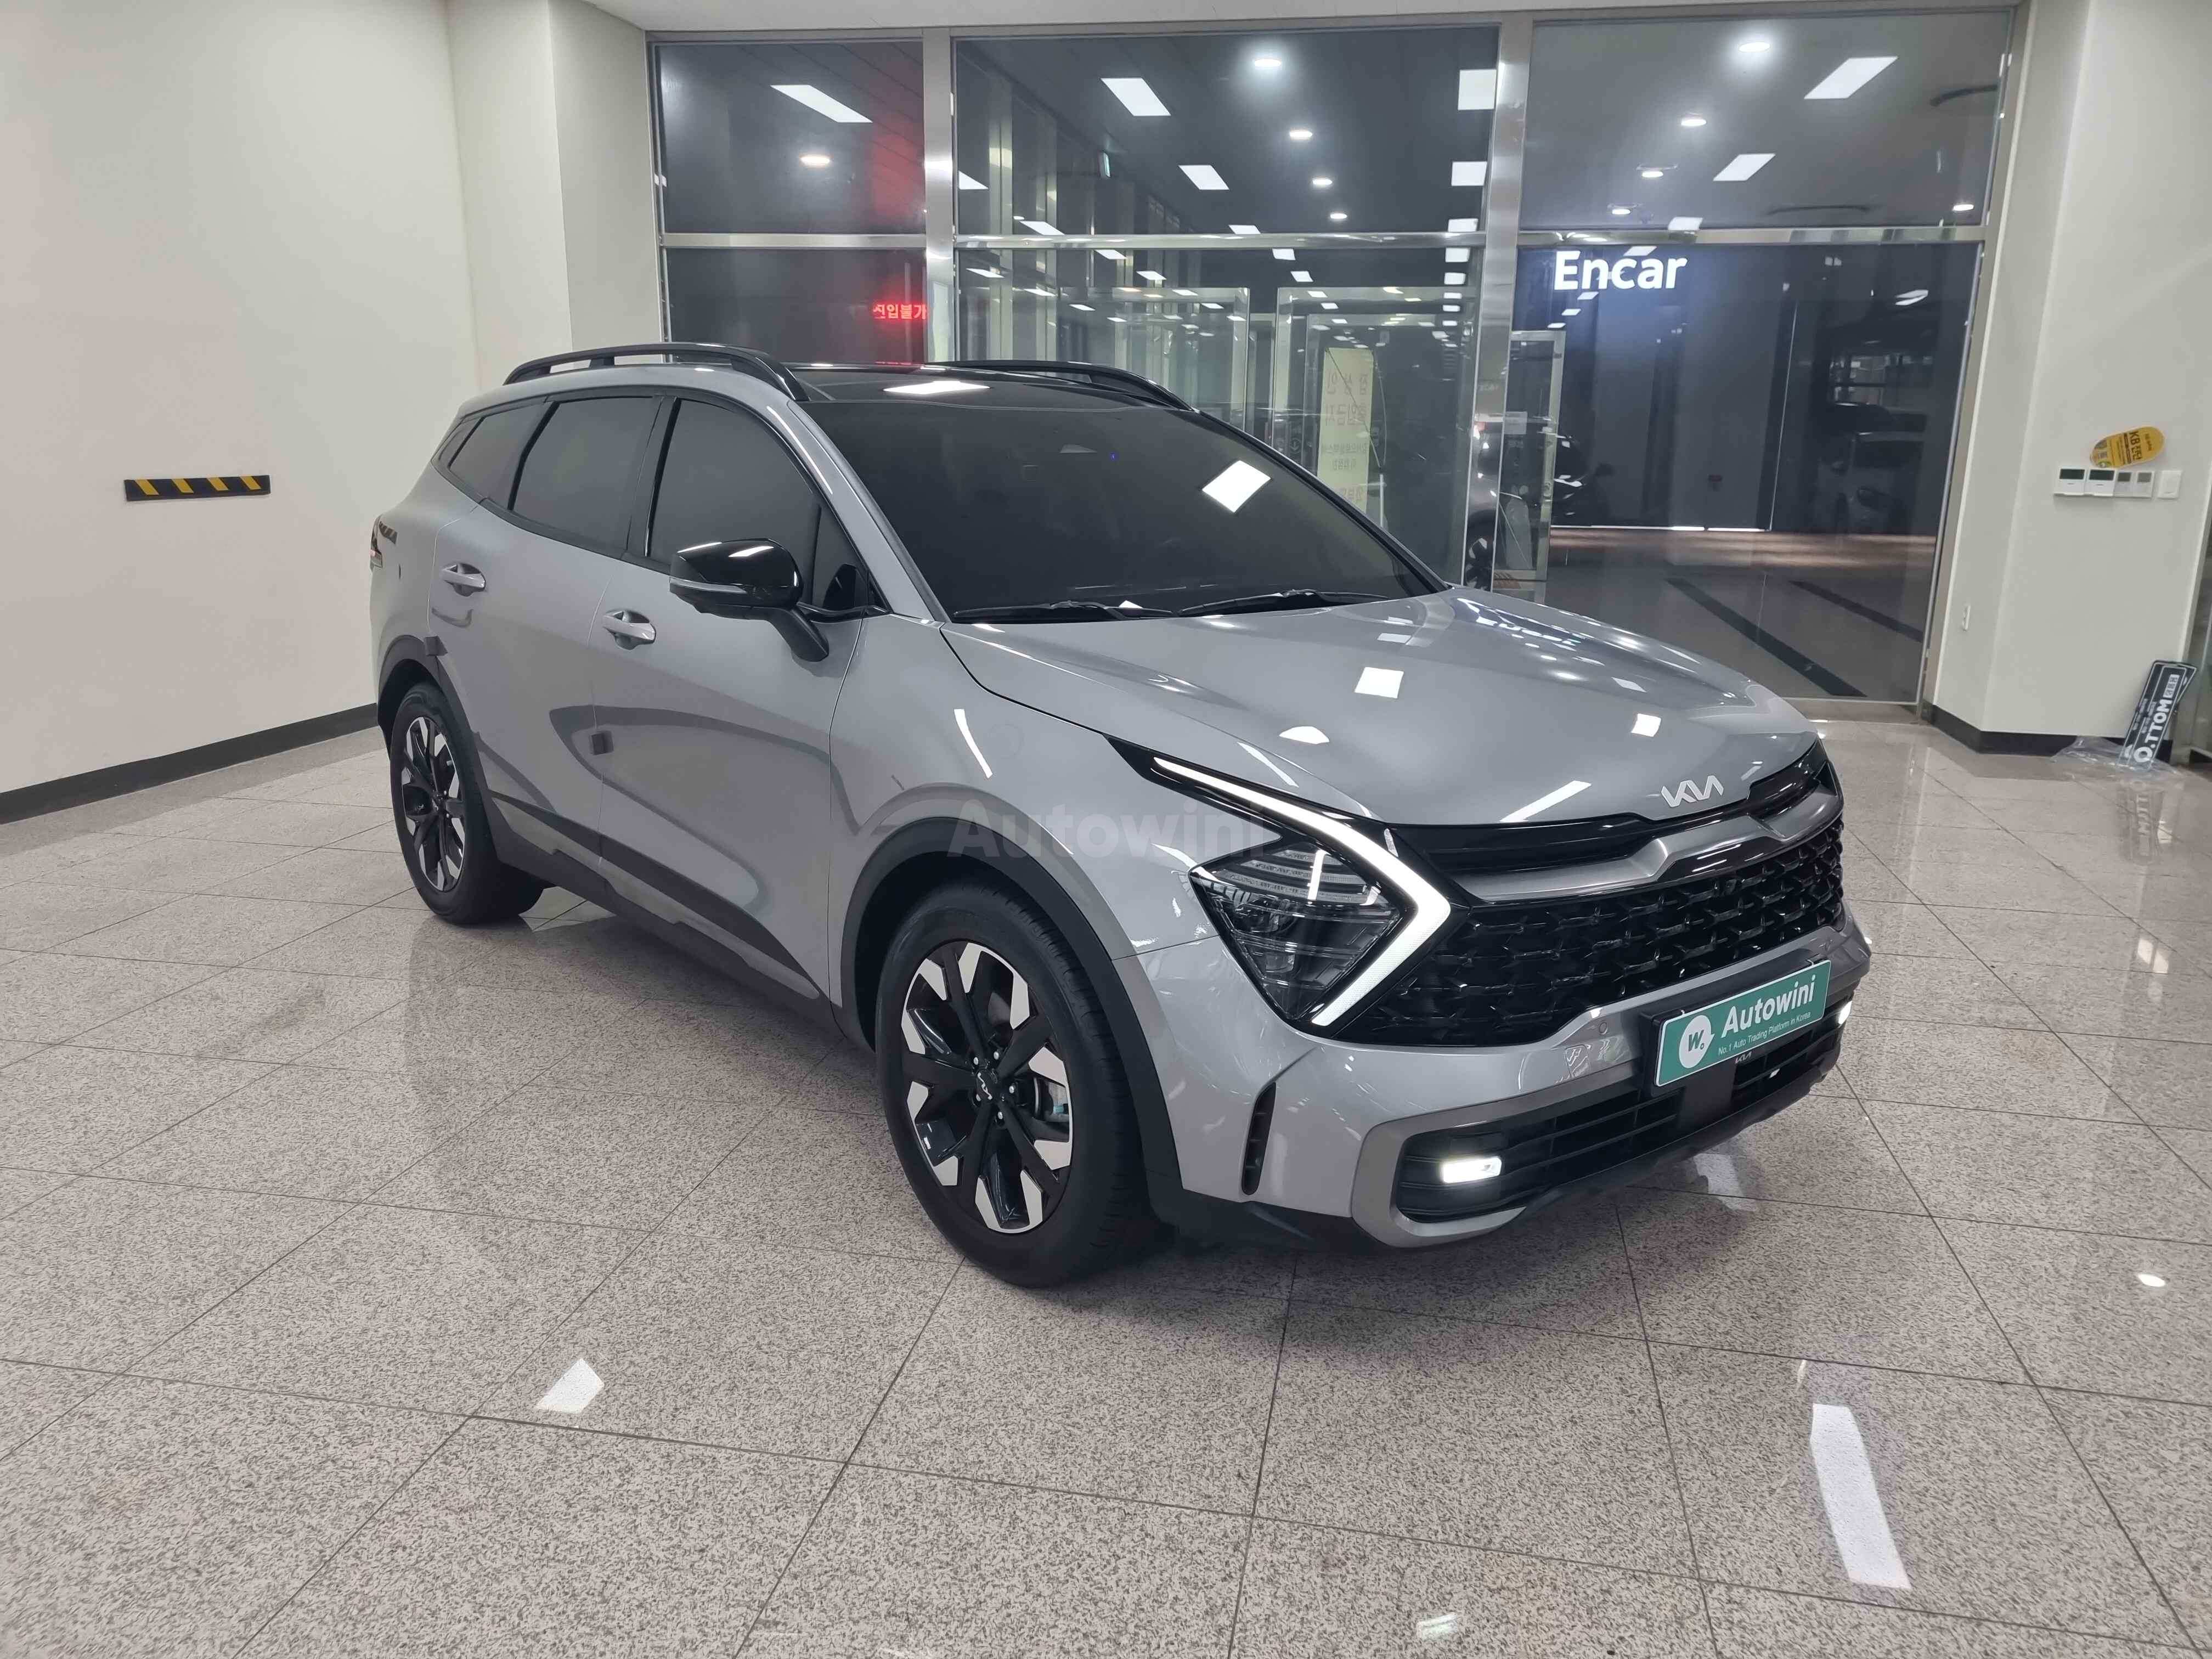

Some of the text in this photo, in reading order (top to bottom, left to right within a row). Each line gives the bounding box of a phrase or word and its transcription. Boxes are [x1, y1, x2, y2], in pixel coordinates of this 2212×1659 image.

[1554, 251, 1688, 290] Encar
[1721, 974, 1815, 1038] Autowini
[1734, 1040, 1746, 1049] Auto
[1747, 1029, 1767, 1042] Trading
[1769, 1019, 1790, 1035] Platform
[1796, 1012, 1810, 1023] Korea
